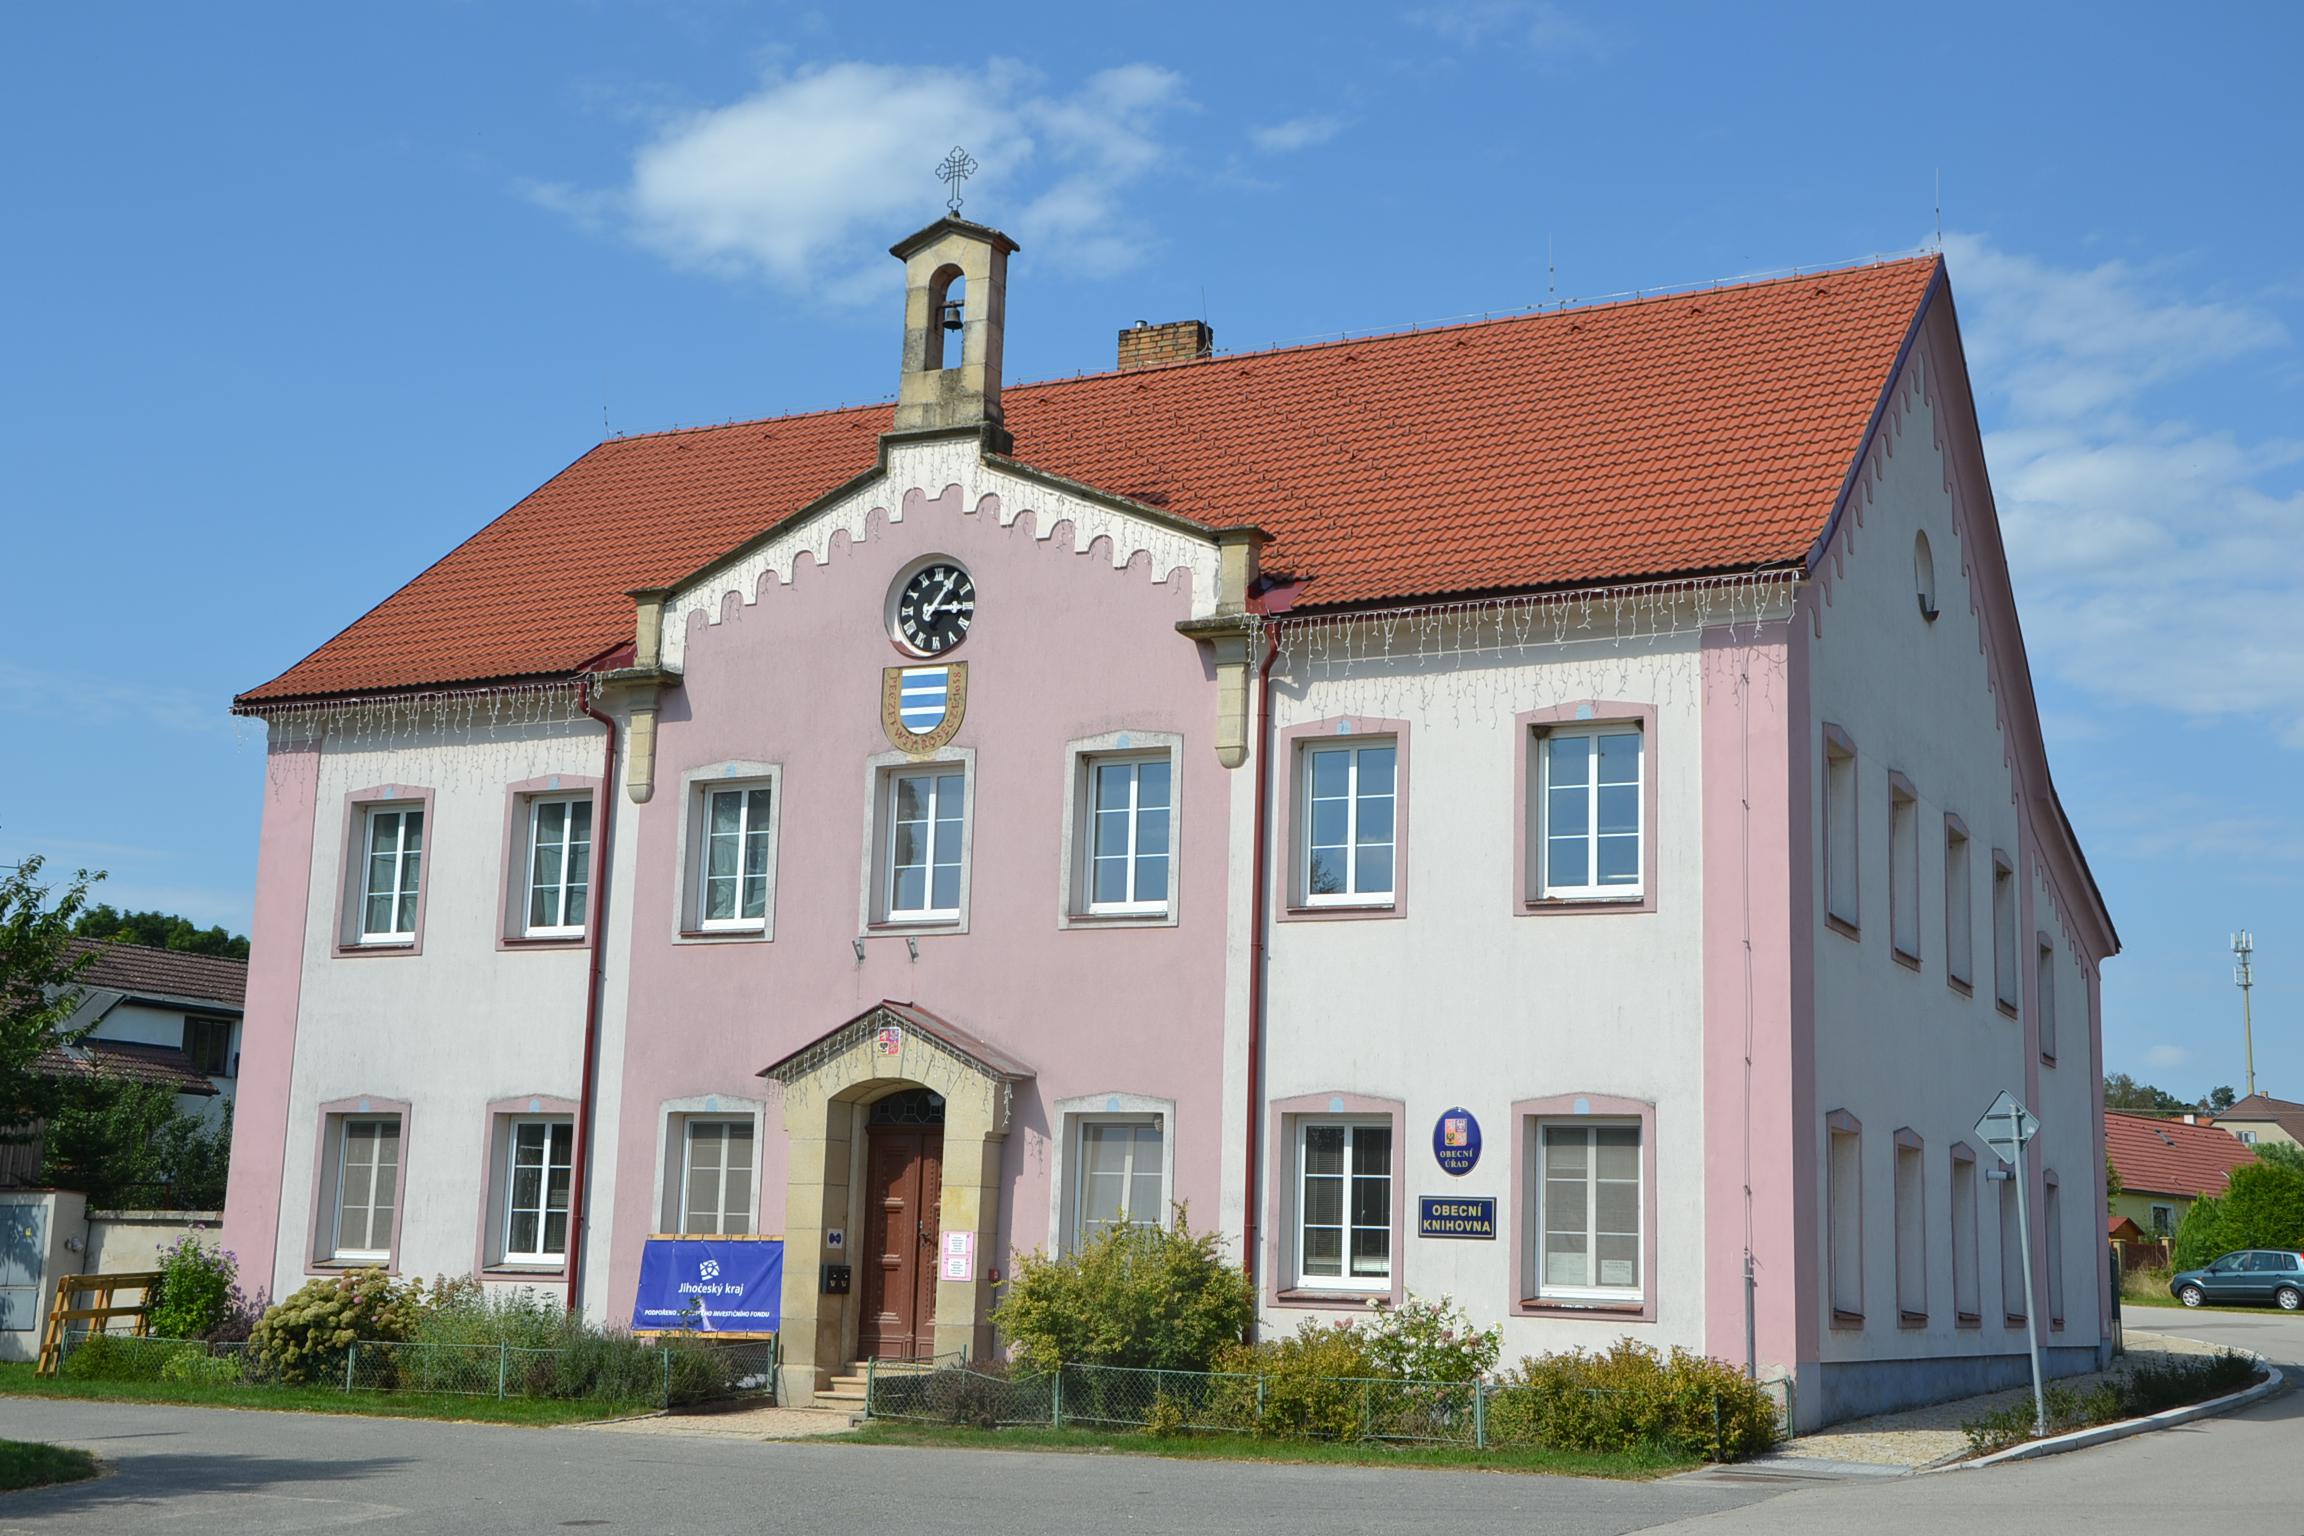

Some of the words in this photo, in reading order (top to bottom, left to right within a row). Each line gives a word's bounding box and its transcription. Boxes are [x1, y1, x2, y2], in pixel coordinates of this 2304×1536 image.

[1439, 1148, 1473, 1158] OBECNÍ
[1444, 1159, 1469, 1168] ÚŘAD
[1432, 1203, 1482, 1217] OBECNÍ
[1423, 1220, 1491, 1232] KNIHOVNA
[678, 1283, 723, 1296] Jihočeský
[725, 1283, 744, 1296] kraj
